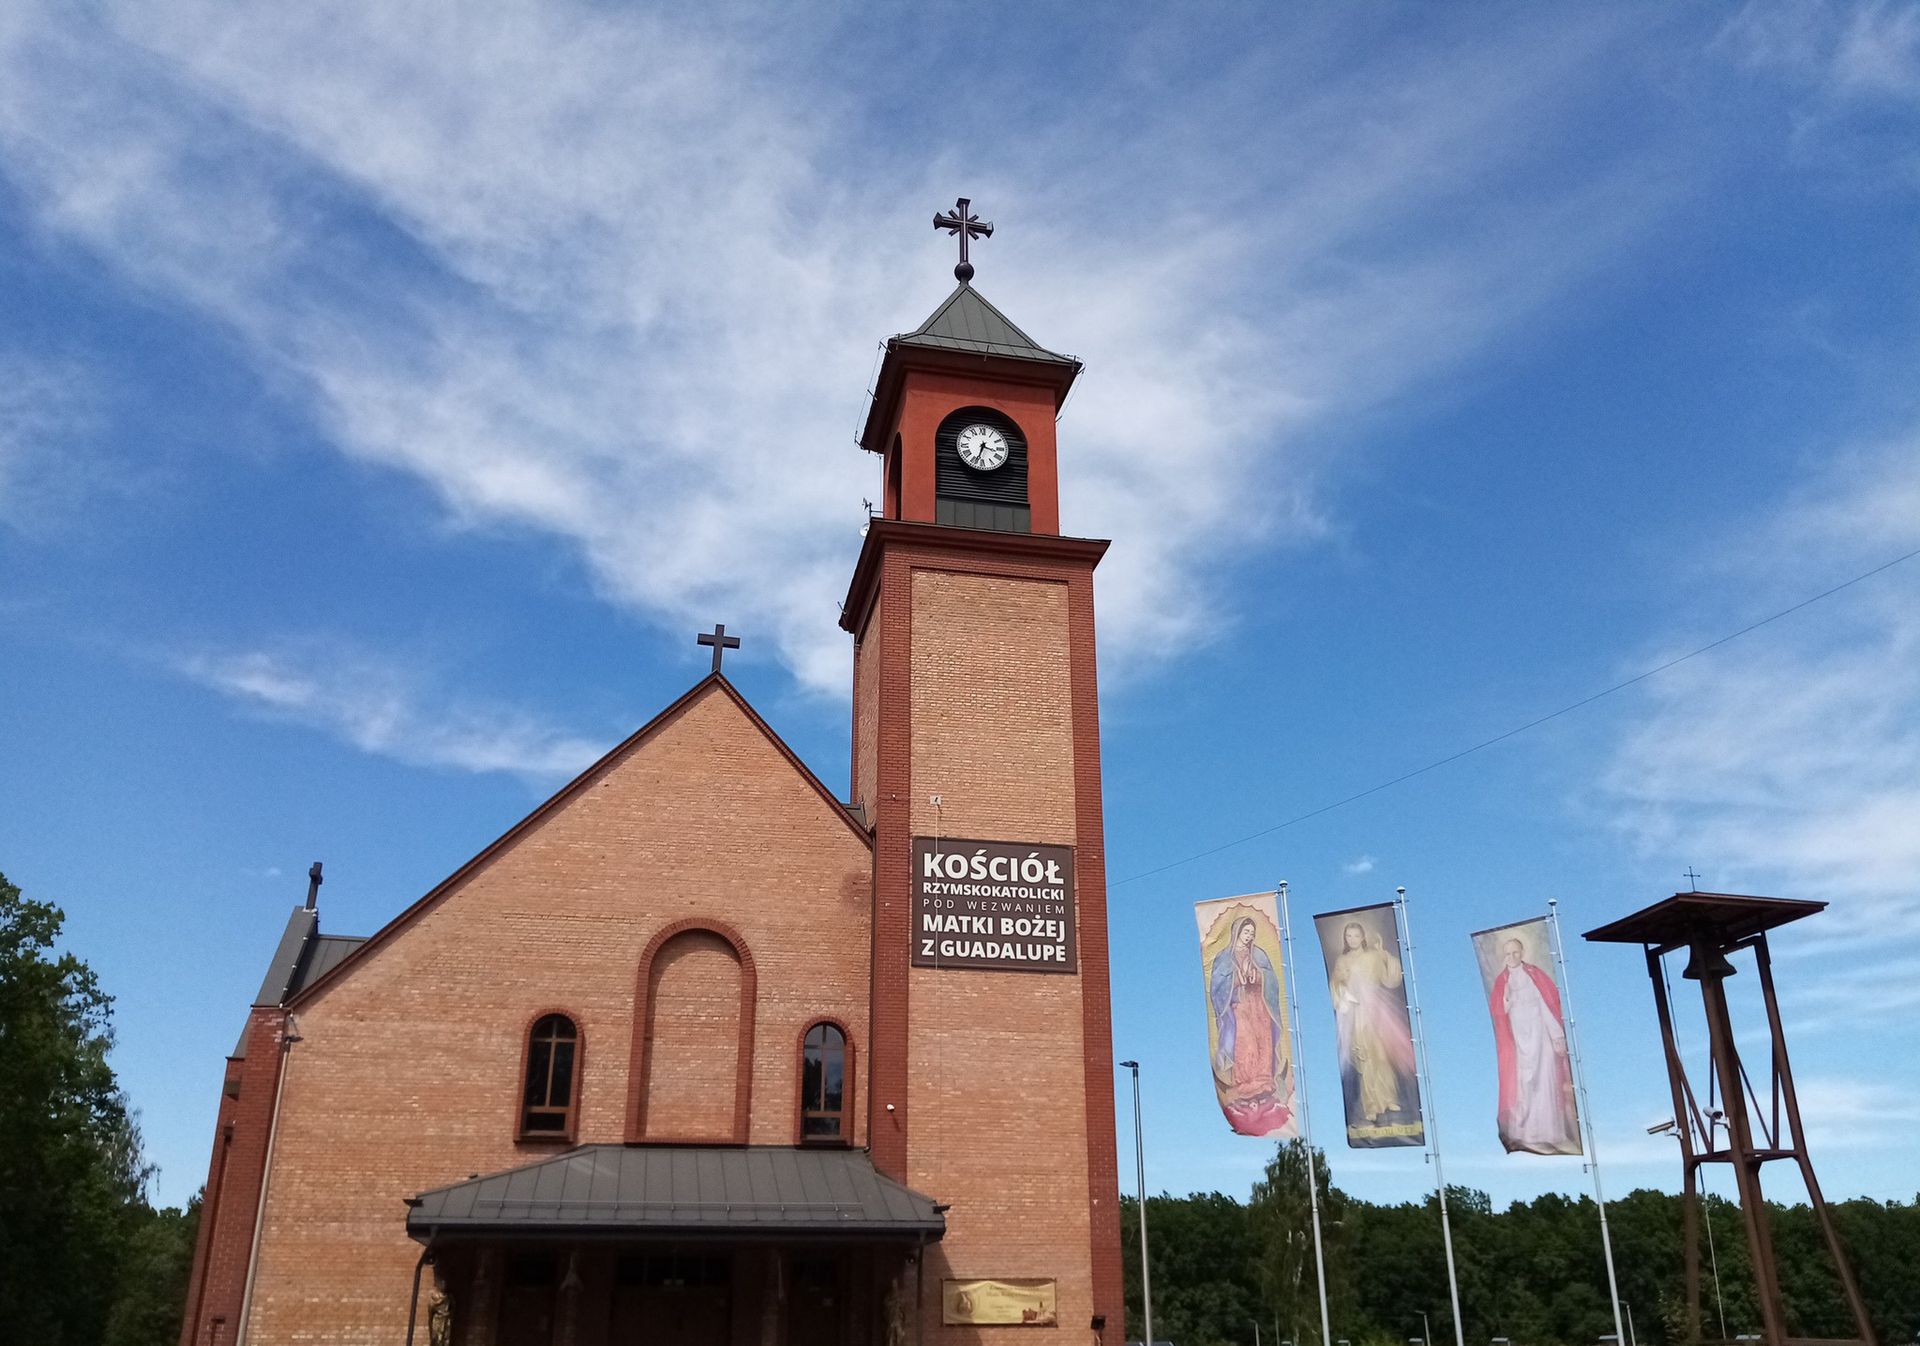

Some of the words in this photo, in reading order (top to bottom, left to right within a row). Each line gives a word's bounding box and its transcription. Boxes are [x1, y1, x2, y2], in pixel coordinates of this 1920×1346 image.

[923, 850, 1064, 884] KOŚCIÓŁ
[923, 882, 1064, 900] RZYMSKOKATOLICKI
[923, 899, 955, 909] POD
[967, 901, 1065, 914] WEZWANIEM
[923, 914, 994, 935] MATKI
[1000, 914, 1066, 942] BOŻEJ
[921, 939, 935, 956] Z
[940, 940, 1066, 962] GUADALUPE
